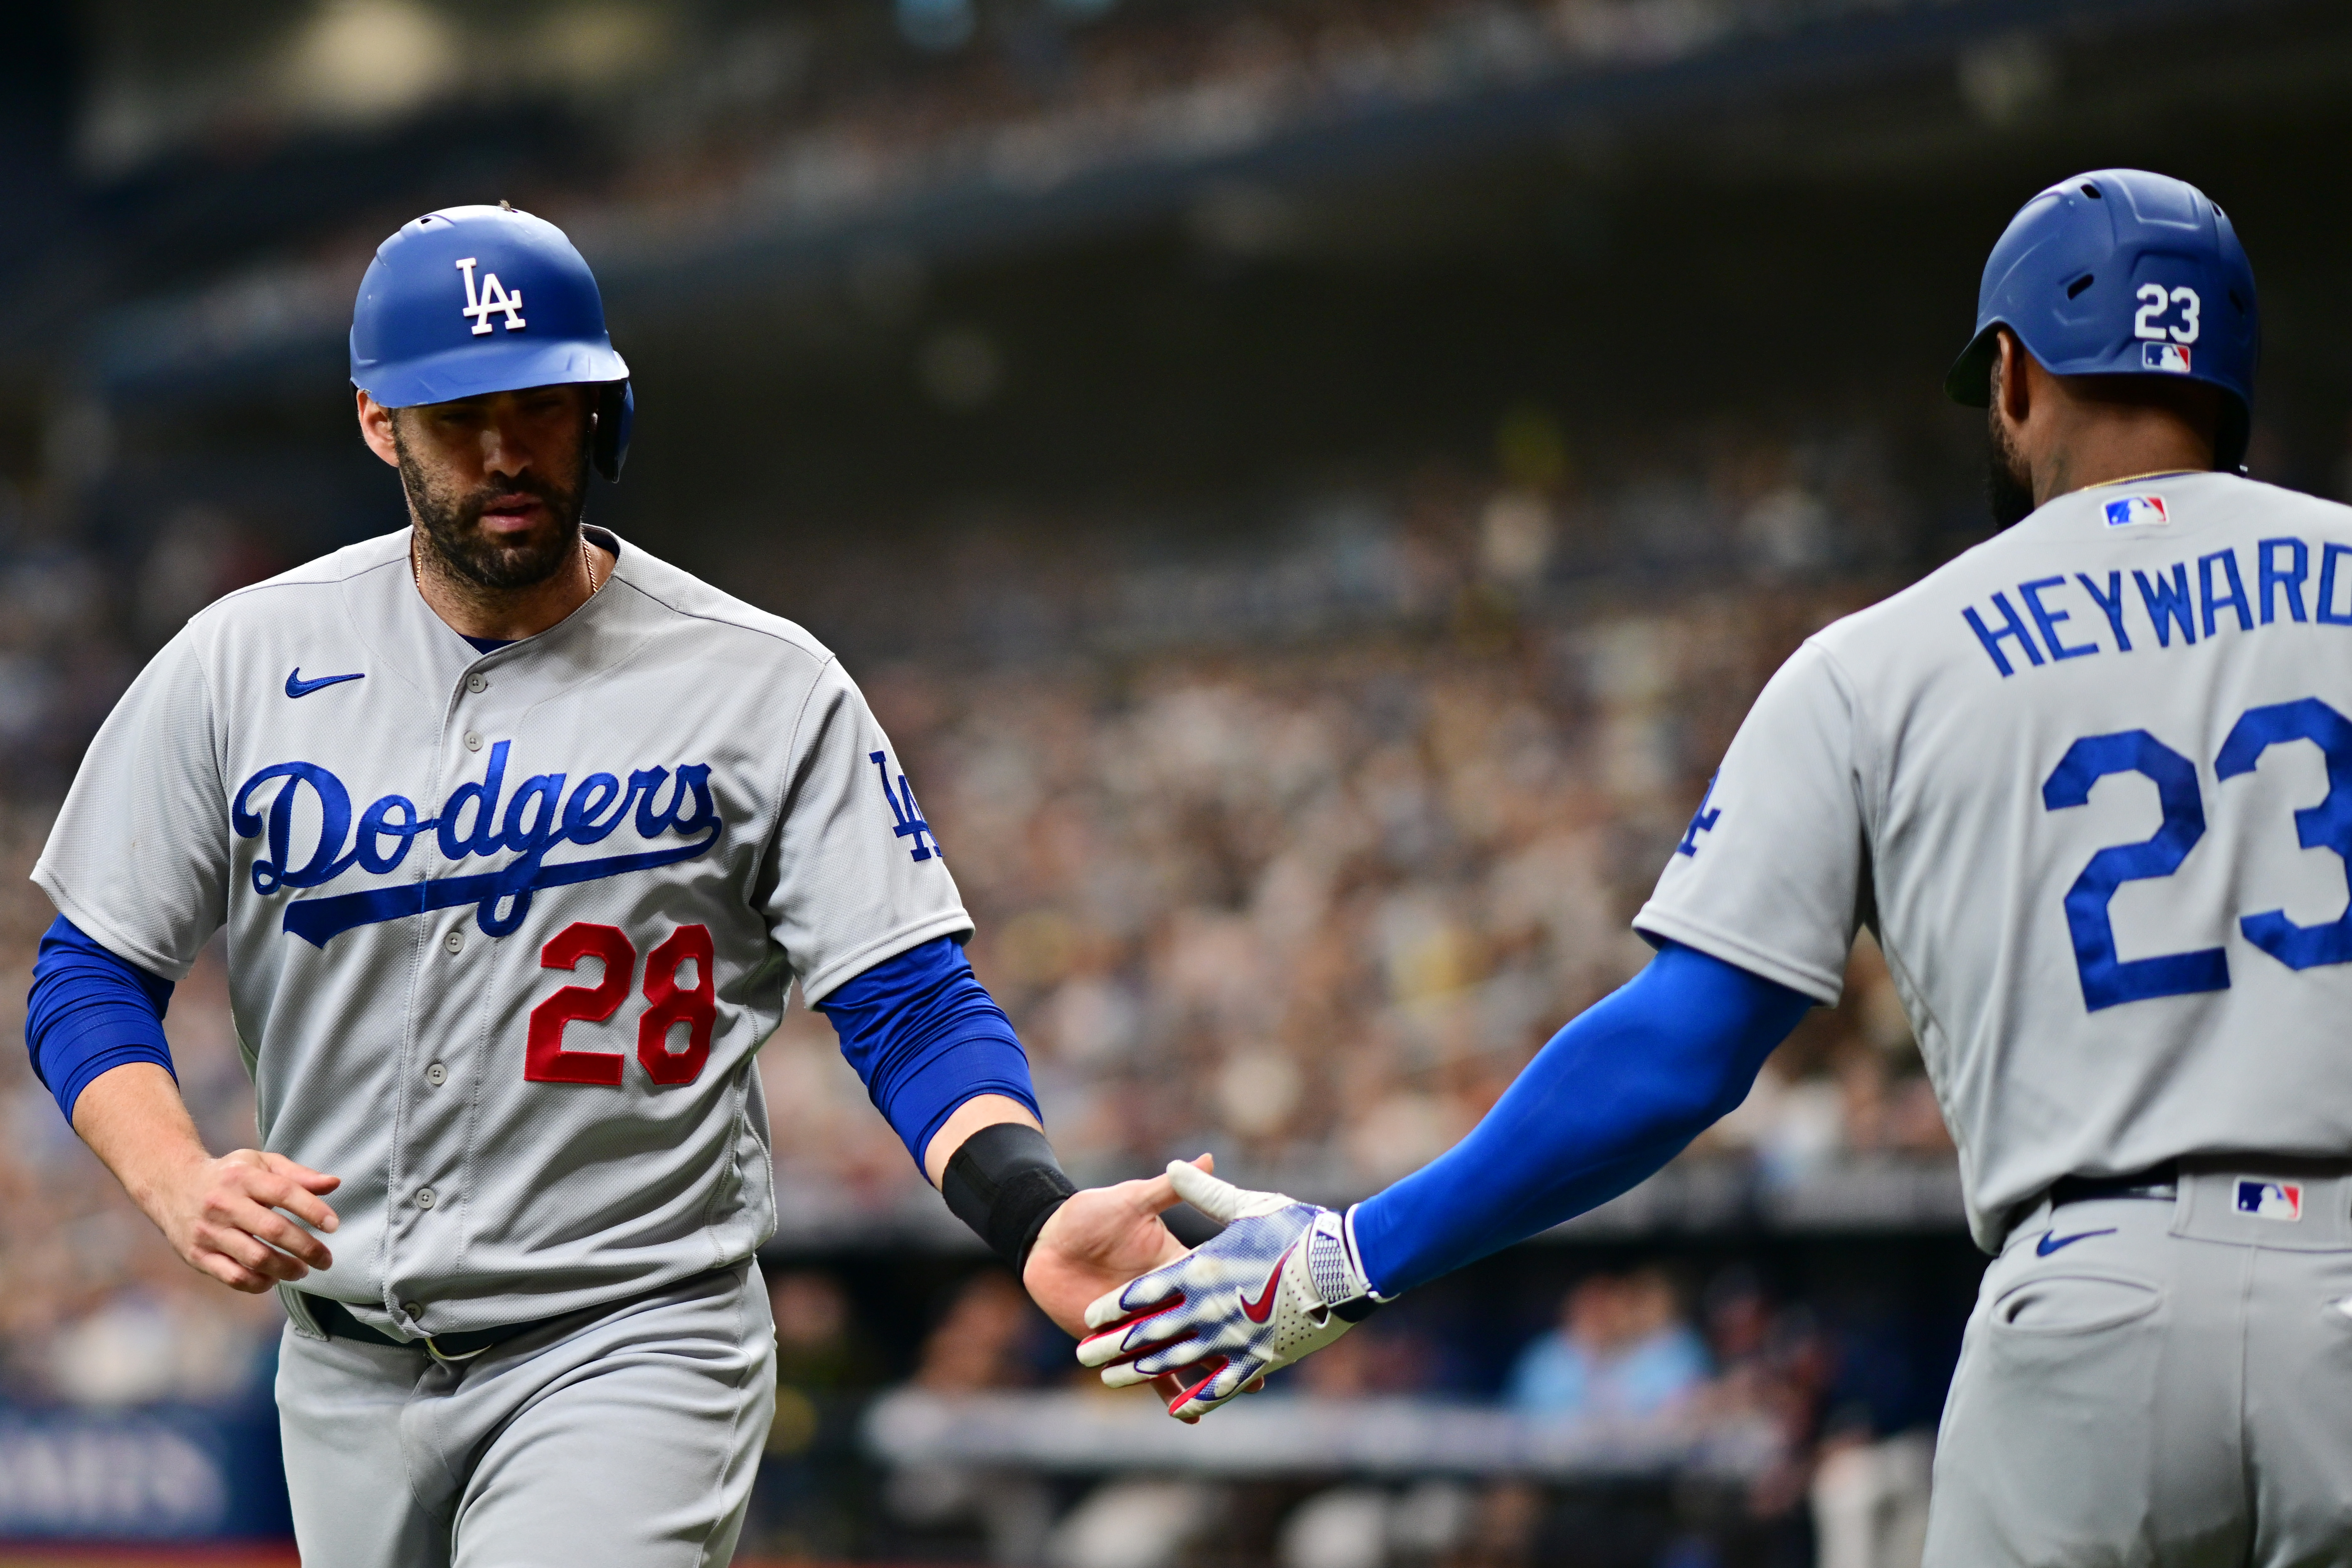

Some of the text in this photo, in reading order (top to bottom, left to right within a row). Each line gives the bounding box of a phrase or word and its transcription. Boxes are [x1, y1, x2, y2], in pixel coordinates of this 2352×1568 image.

[456, 257, 526, 335] LA
[2135, 284, 2200, 344] 23
[1962, 536, 2352, 678] HEYWARD
[232, 740, 722, 940] Dodgers
[2042, 697, 2352, 1013] 23
[524, 922, 717, 1085] 28
